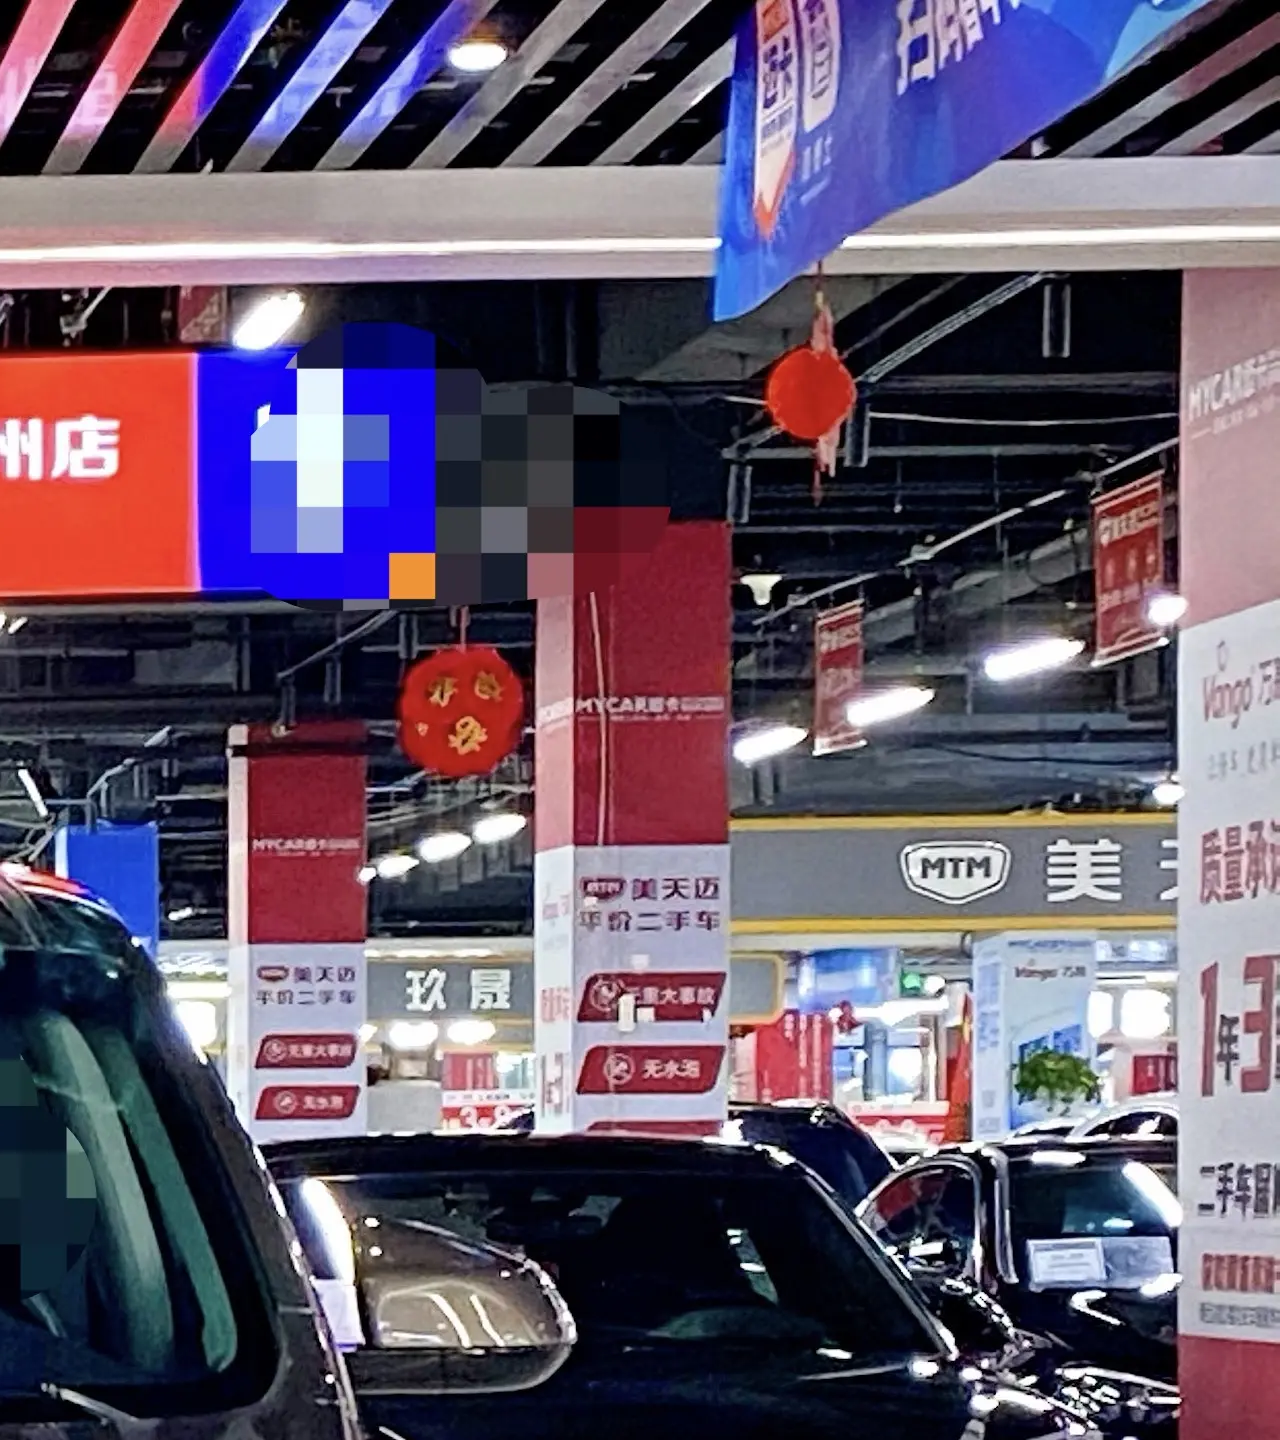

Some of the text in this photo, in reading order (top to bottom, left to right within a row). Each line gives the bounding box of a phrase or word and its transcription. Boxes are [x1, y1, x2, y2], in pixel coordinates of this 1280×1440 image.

[920, 838, 1178, 901] MTM 美
[632, 877, 720, 901] 美天迈
[579, 910, 720, 933] 平价二手车
[405, 968, 511, 1012] 玖晟
